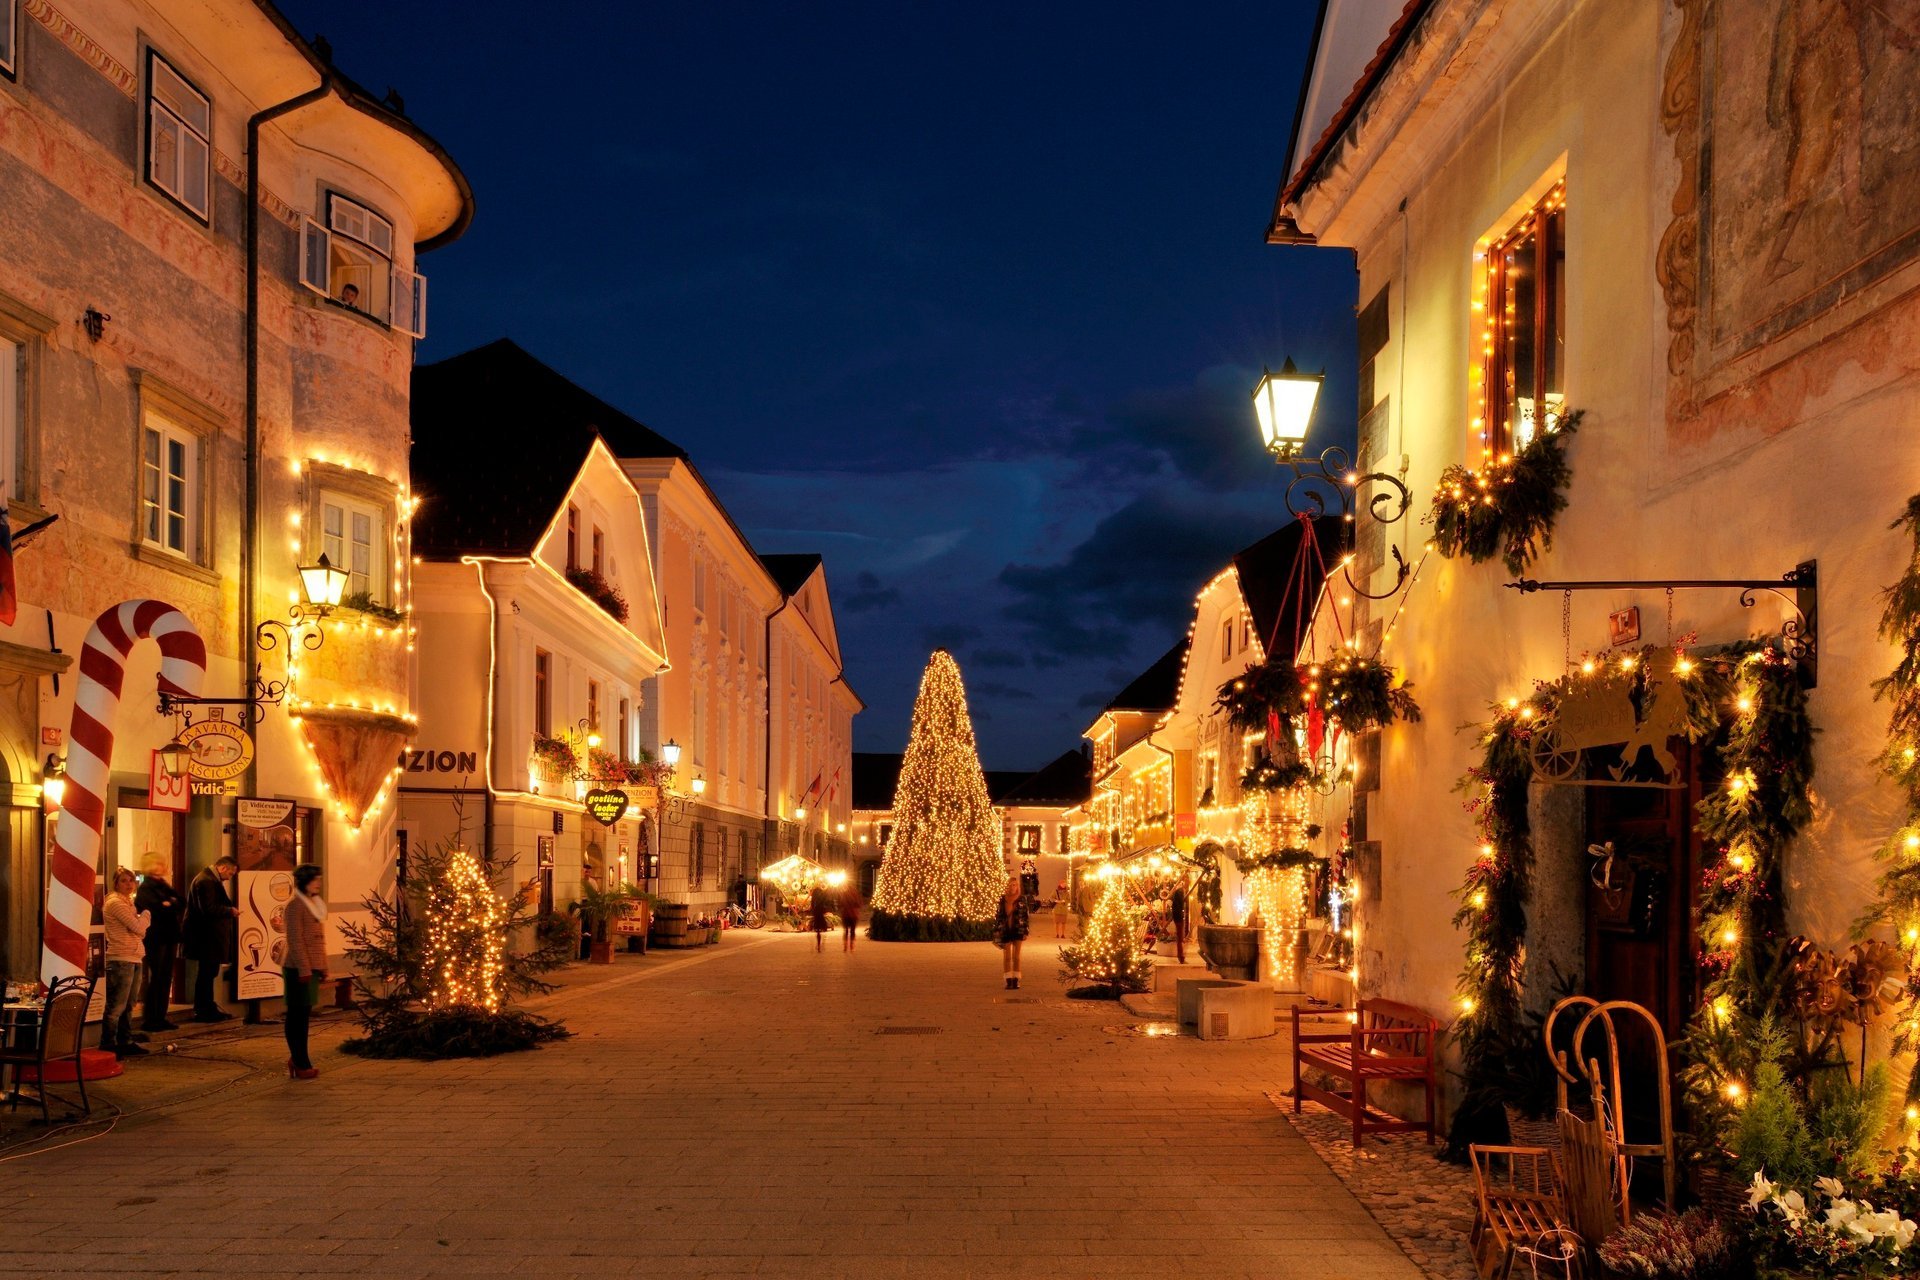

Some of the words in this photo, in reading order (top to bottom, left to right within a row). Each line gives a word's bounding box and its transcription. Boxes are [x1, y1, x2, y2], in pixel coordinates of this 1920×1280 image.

[1616, 611, 1630, 633] 17
[50, 729, 56, 739] 3
[184, 723, 246, 743] KAVARNA
[190, 756, 251, 778] AŠČIČARNA
[155, 765, 184, 797] 50
[190, 782, 225, 795] Vidic
[588, 795, 624, 804] gostilna
